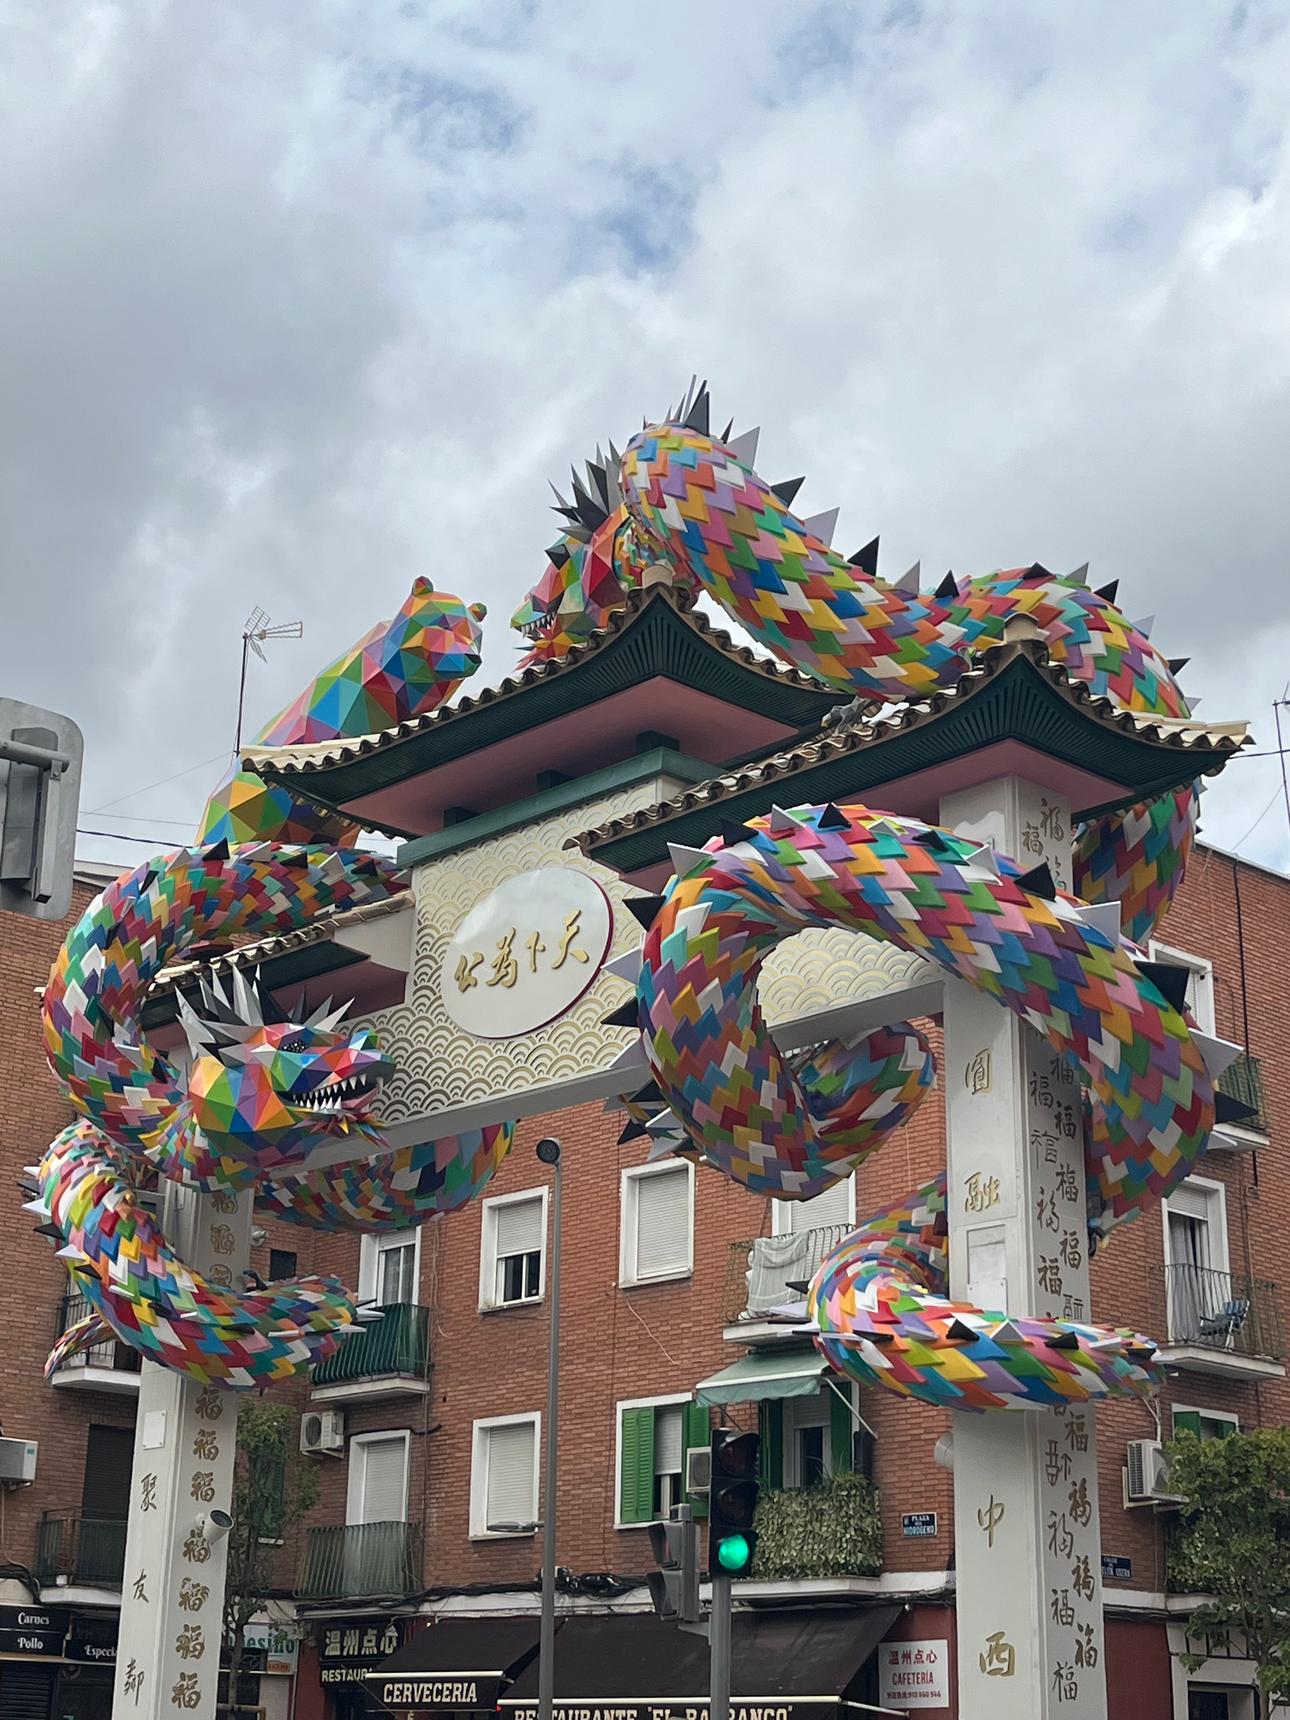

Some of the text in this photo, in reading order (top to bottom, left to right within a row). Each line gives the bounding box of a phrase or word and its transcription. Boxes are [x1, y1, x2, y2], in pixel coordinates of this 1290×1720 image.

[17, 1612, 50, 1625] Carnes
[17, 1637, 44, 1650] Pollo
[325, 1628, 399, 1656] 温州点心
[84, 1645, 118, 1659] Especi
[321, 1669, 373, 1683] RESTAUR
[892, 1670, 934, 1686] CAFETERÍA
[383, 1682, 478, 1704] CERVECERIA
